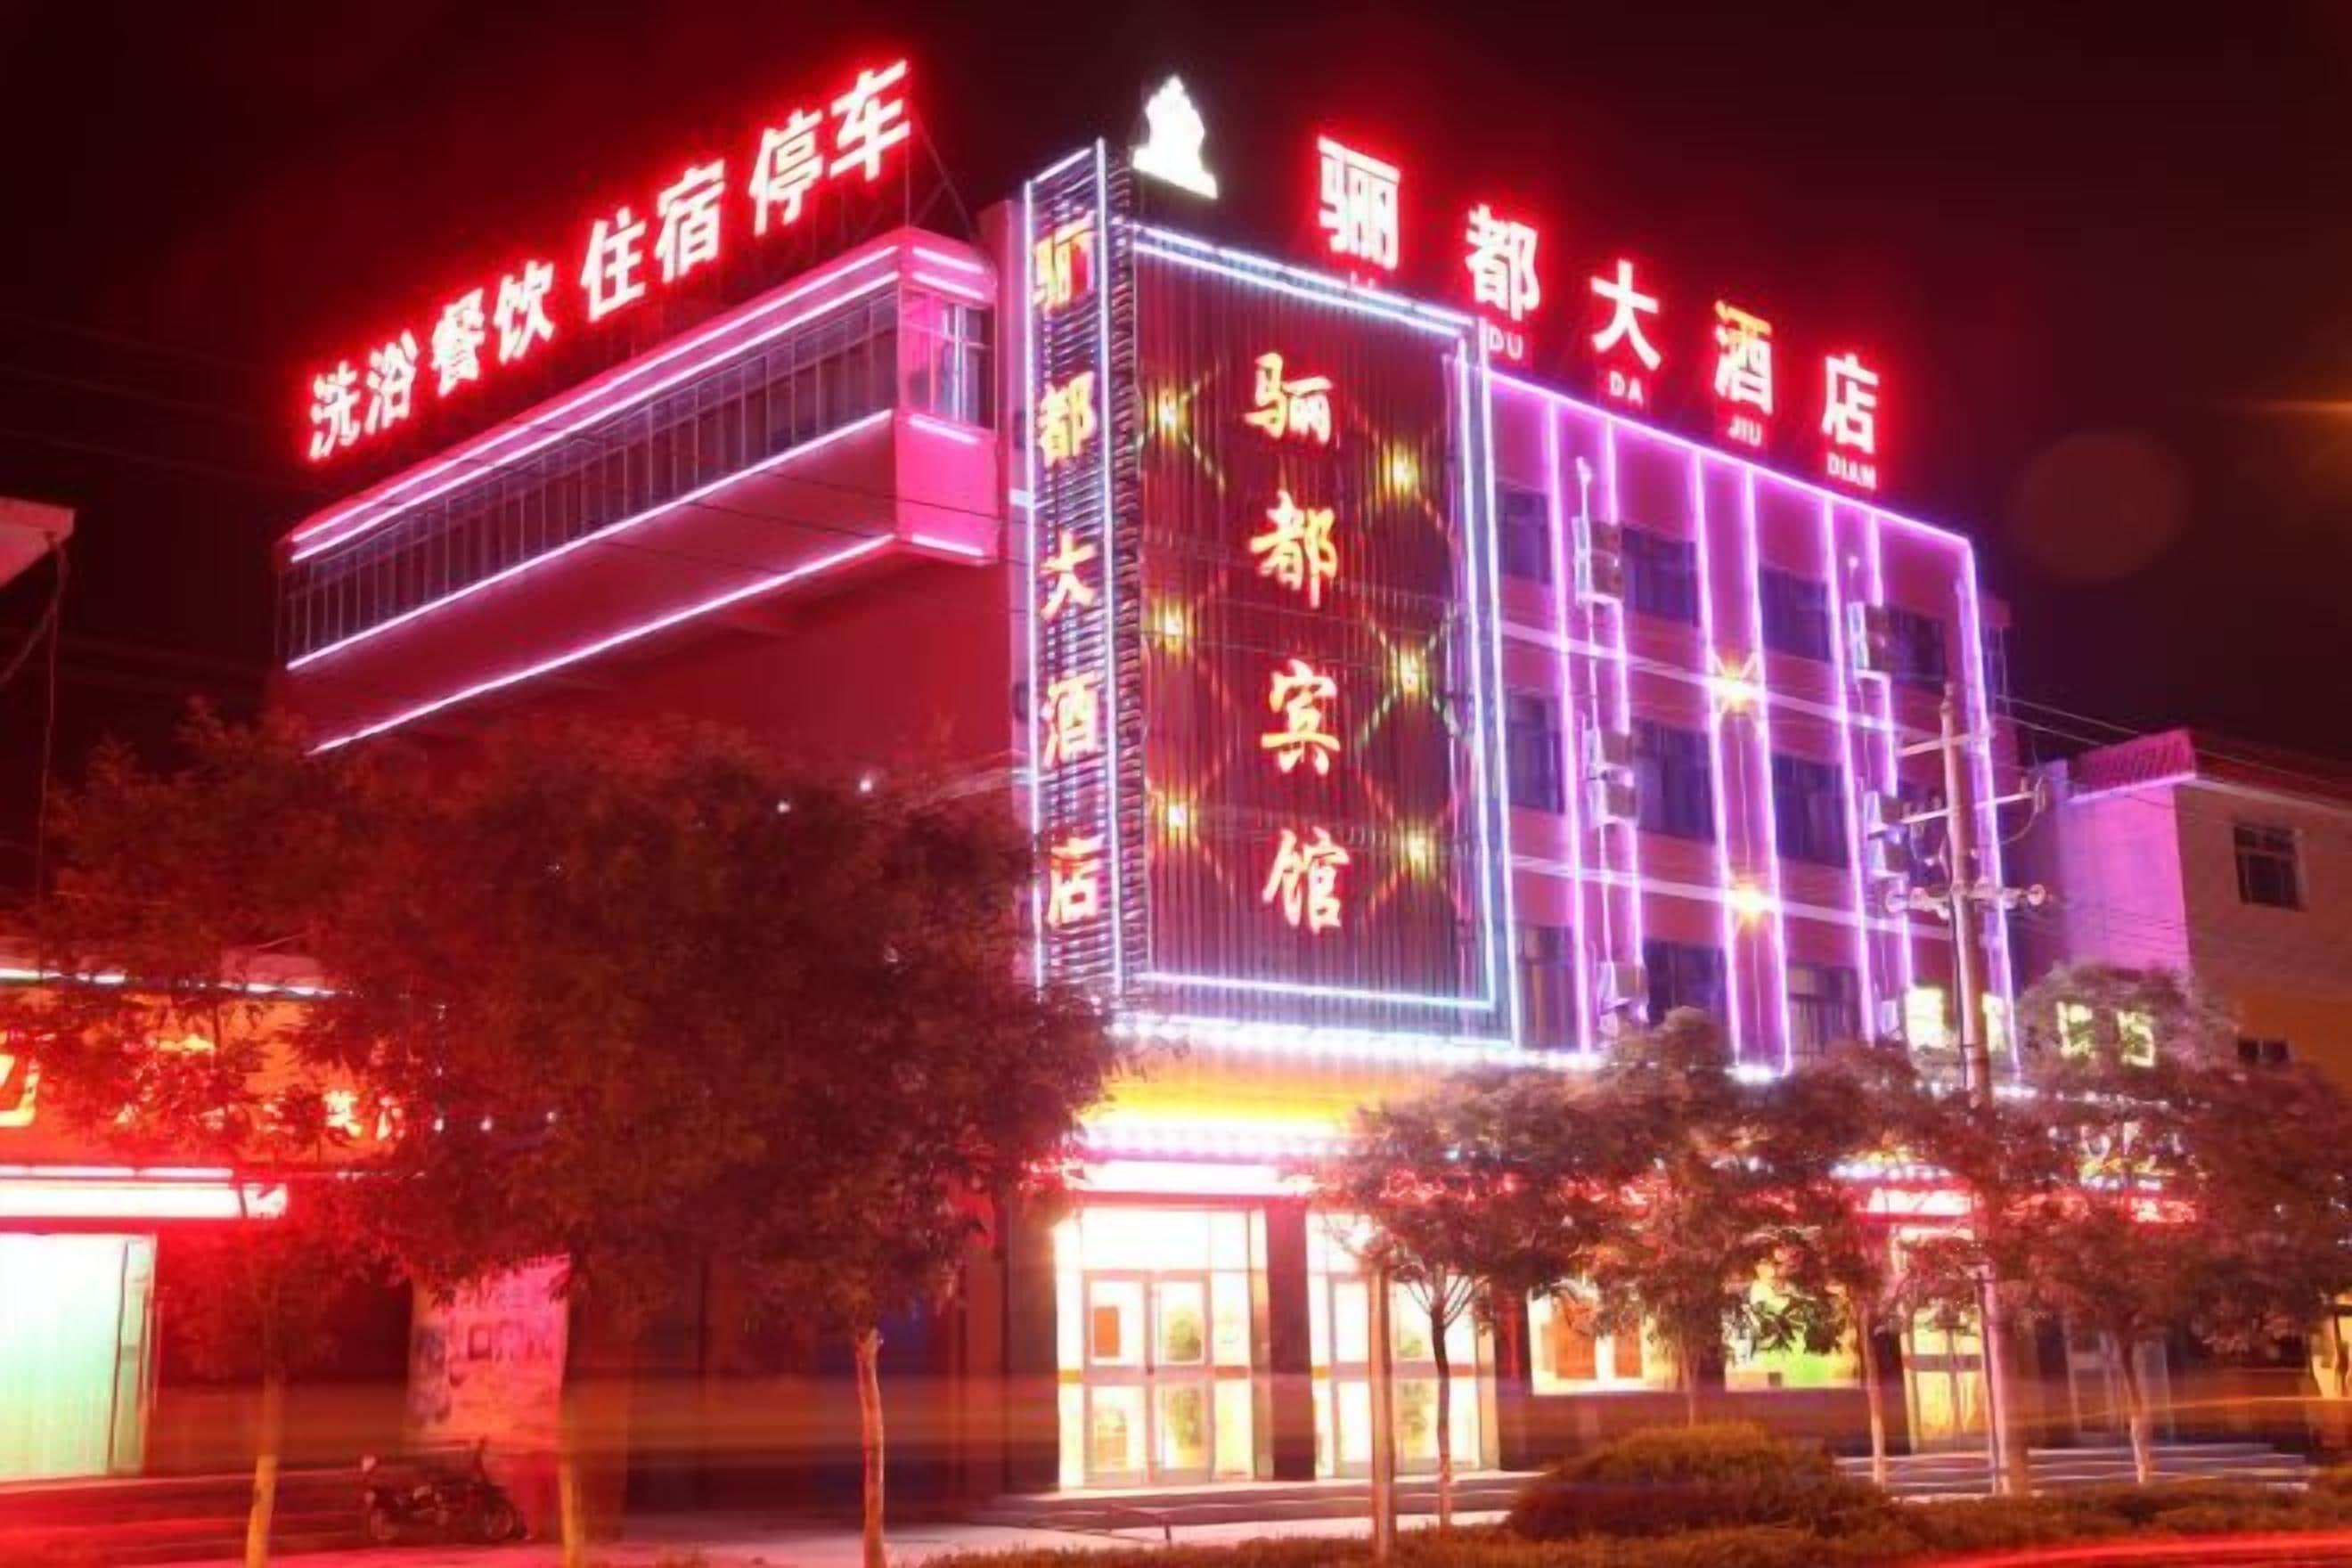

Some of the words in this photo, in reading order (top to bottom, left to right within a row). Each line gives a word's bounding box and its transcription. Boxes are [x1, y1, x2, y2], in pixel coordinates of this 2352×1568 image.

[1318, 135, 1879, 453] 骊都大酒店
[1609, 370, 1644, 407] DA
[1727, 415, 1762, 446] JIU
[1244, 352, 1349, 934] 骊都宾馆
